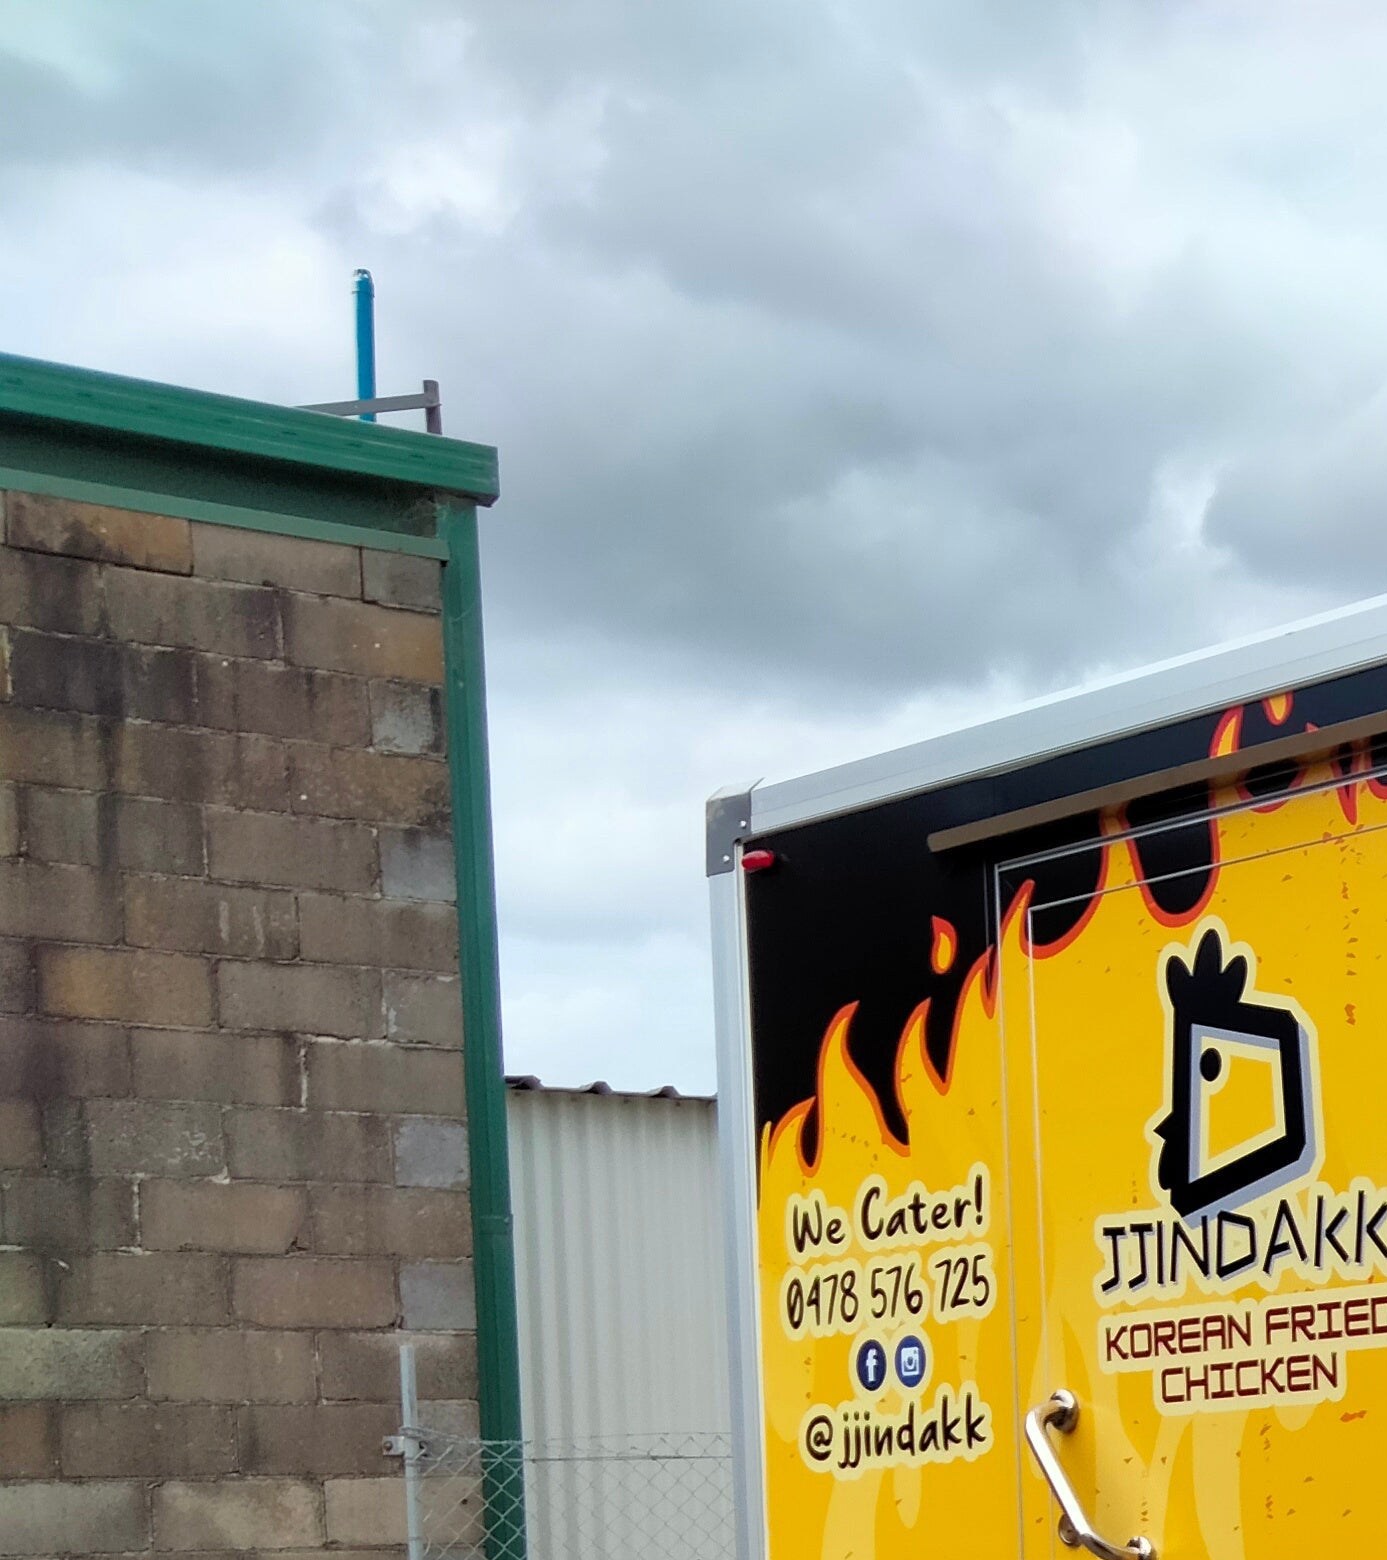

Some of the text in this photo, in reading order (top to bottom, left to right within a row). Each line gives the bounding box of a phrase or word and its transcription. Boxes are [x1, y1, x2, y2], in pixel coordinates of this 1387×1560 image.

[793, 1174, 984, 1253] We Cater!
[786, 1254, 990, 1330] 0478 576 725
[1105, 1311, 1252, 1361] KOREAN
[1161, 1352, 1338, 1403] CHICKEN
[806, 1392, 986, 1469] @jjindakk
